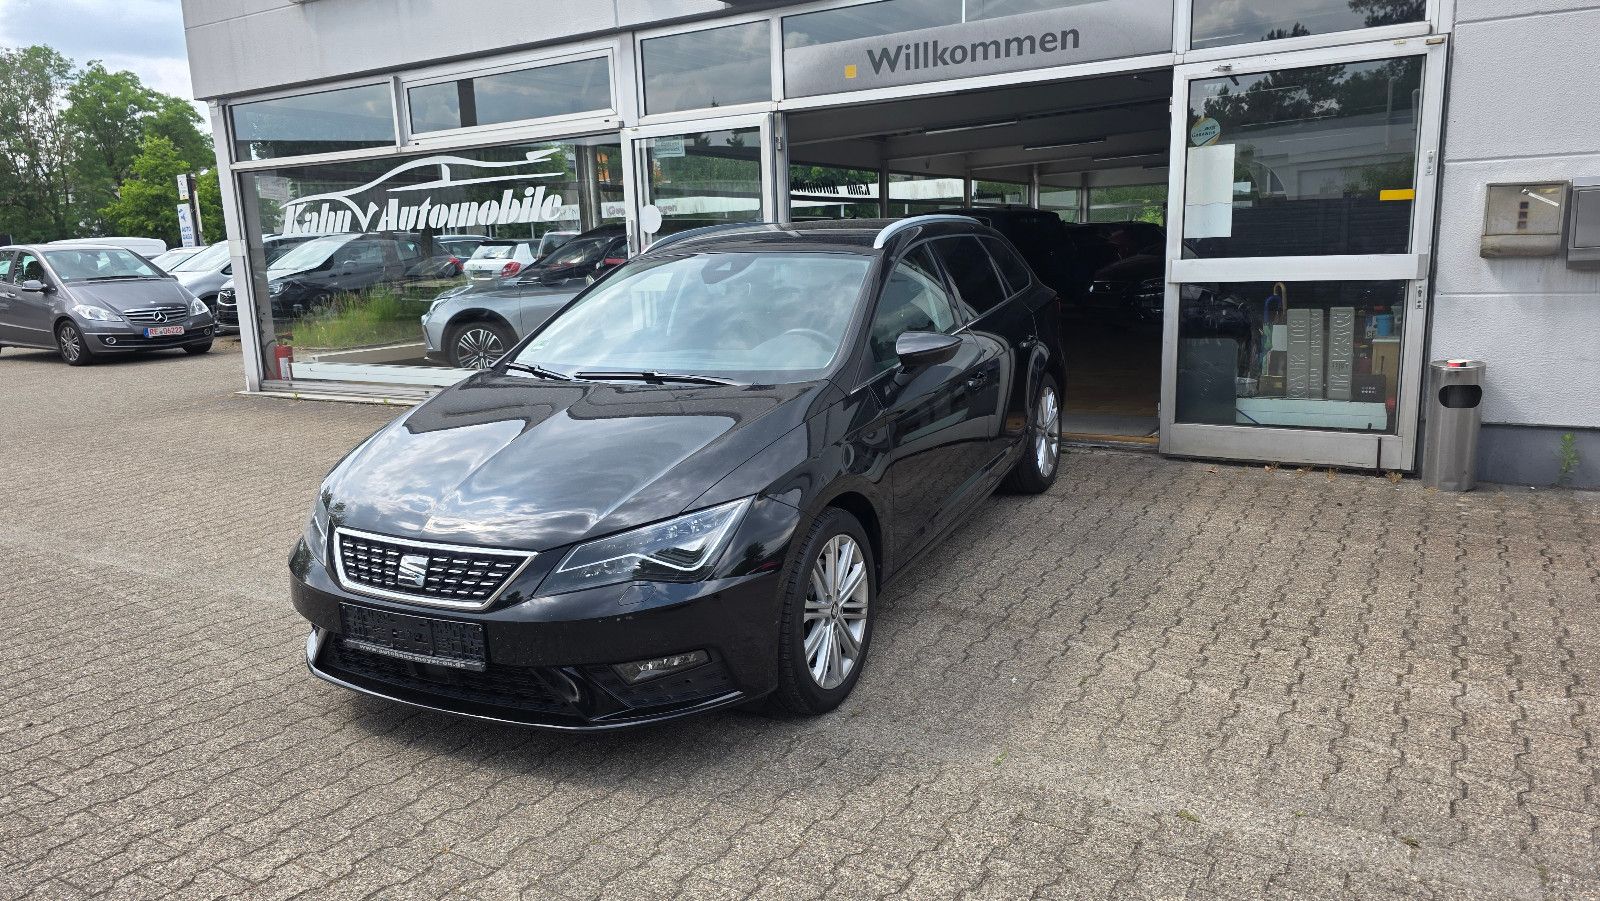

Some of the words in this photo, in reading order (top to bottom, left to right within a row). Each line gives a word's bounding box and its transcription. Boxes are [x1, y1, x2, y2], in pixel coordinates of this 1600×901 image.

[866, 28, 1080, 75] Willkommen
[282, 202, 351, 236] Kahn
[376, 185, 563, 232] Automobile
